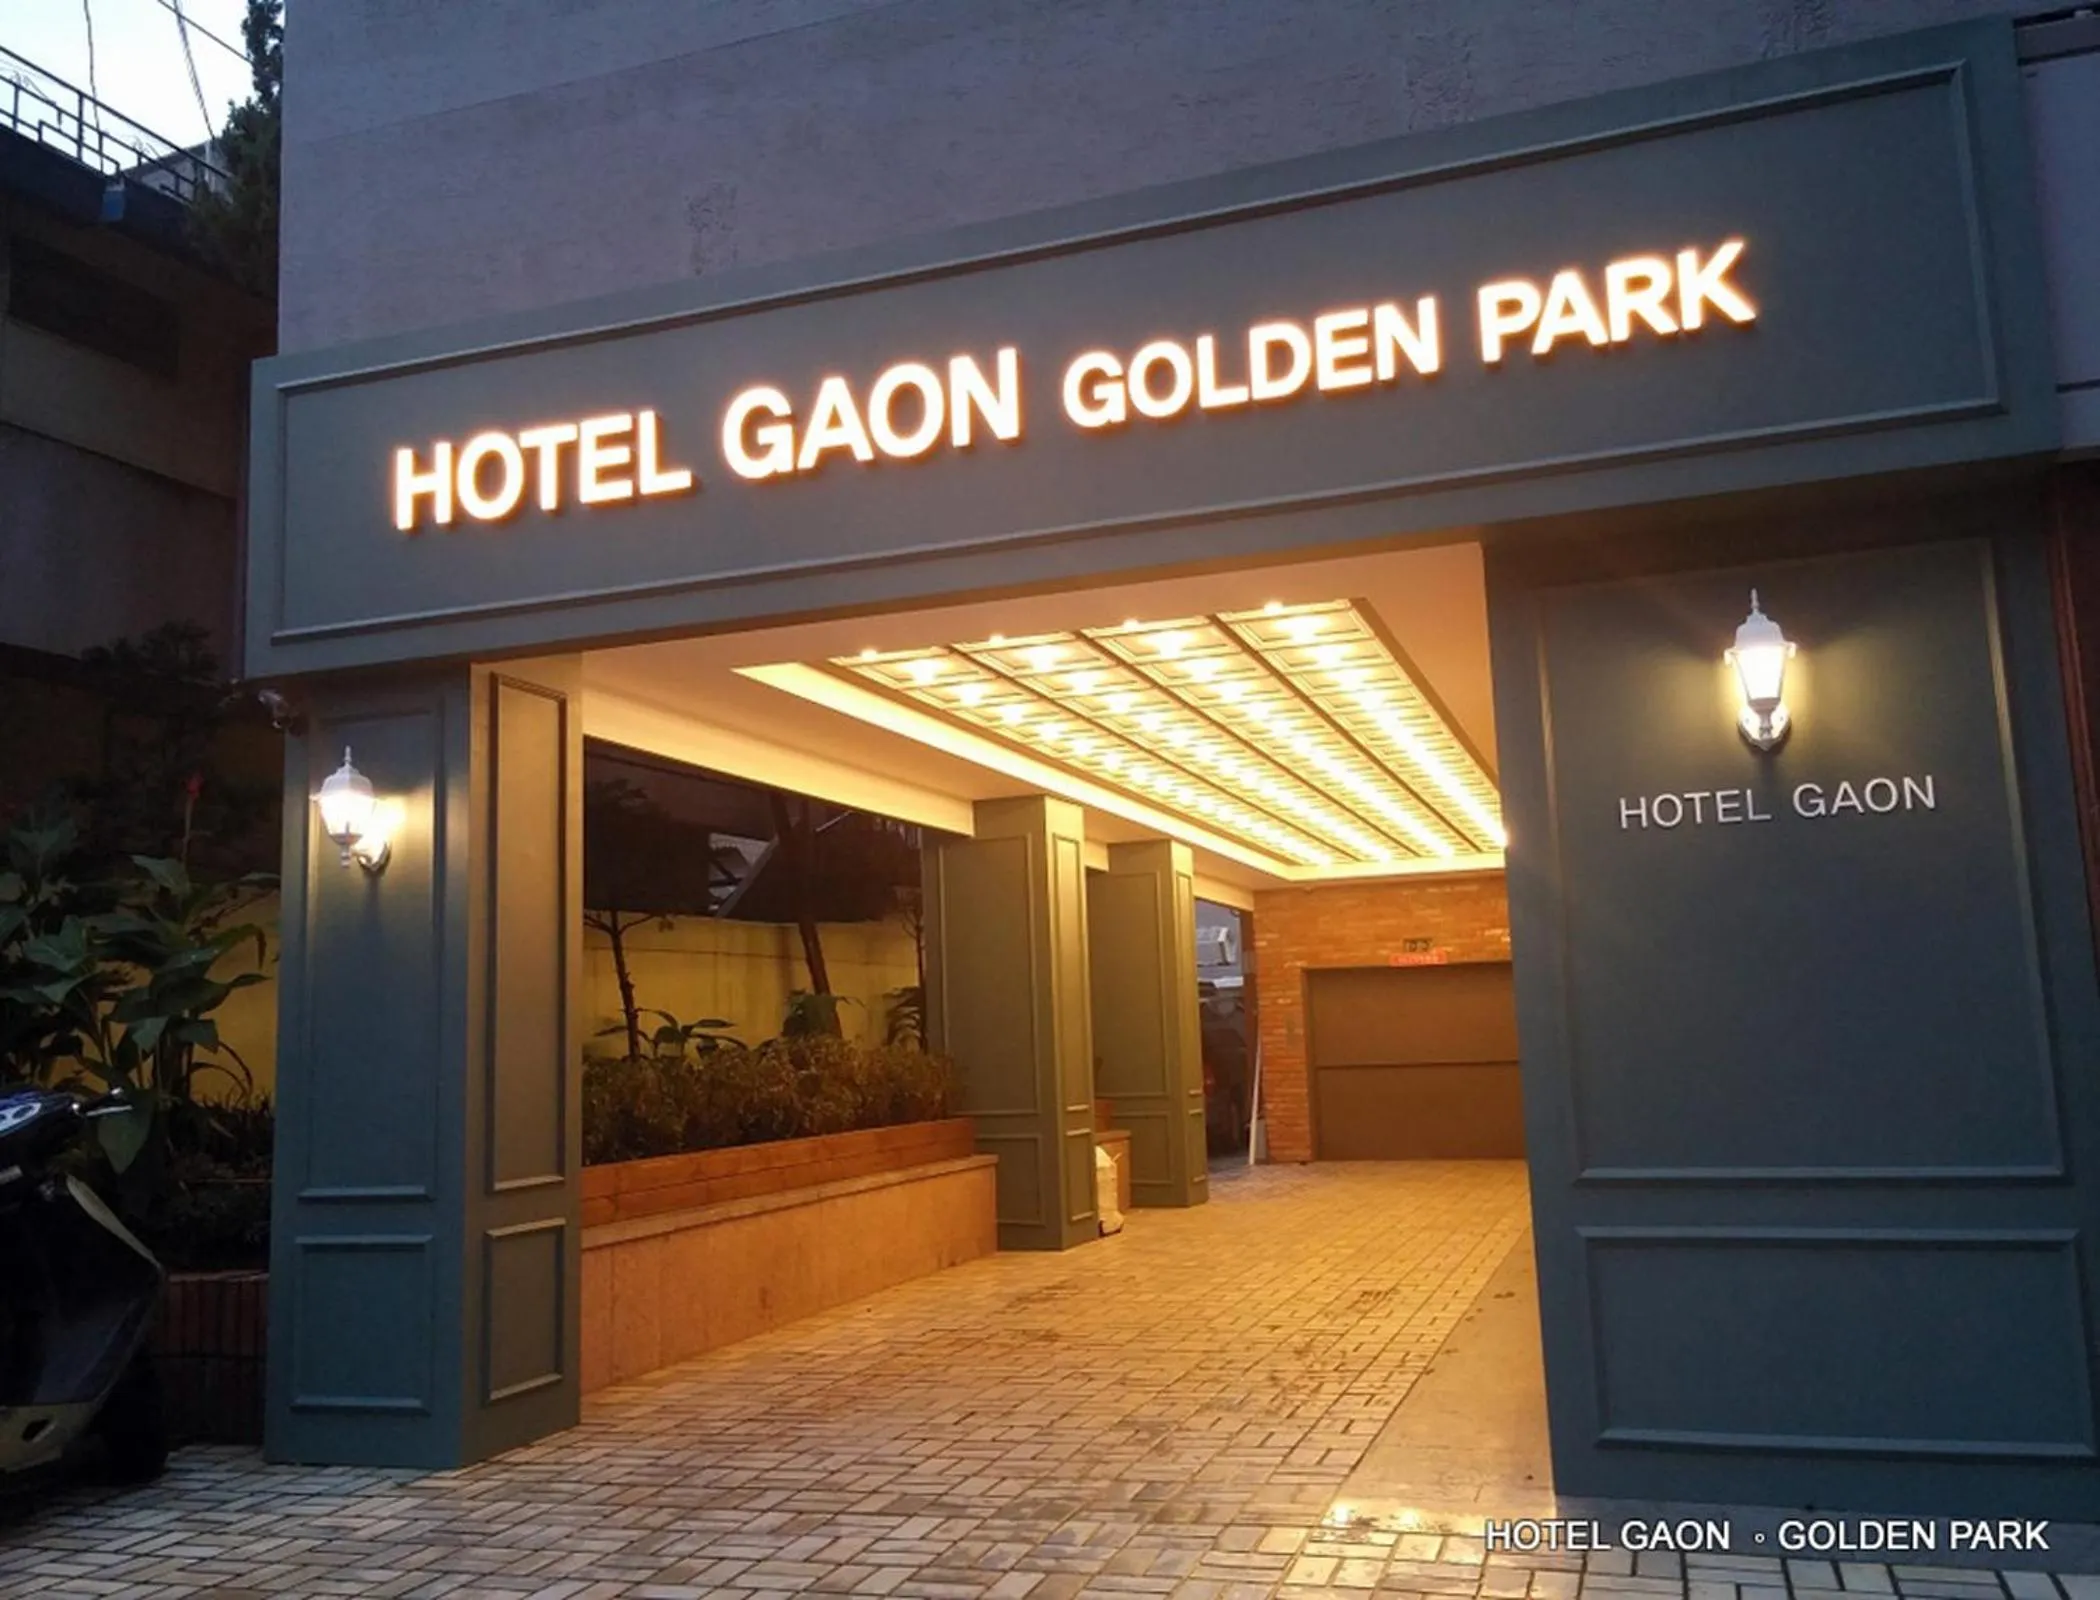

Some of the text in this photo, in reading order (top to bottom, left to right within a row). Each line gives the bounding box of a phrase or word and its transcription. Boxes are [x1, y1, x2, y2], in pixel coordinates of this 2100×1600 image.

[393, 238, 1758, 531] HOTEL GAON GOLDEN PARK
[1618, 774, 1937, 829] HOTEL GAON
